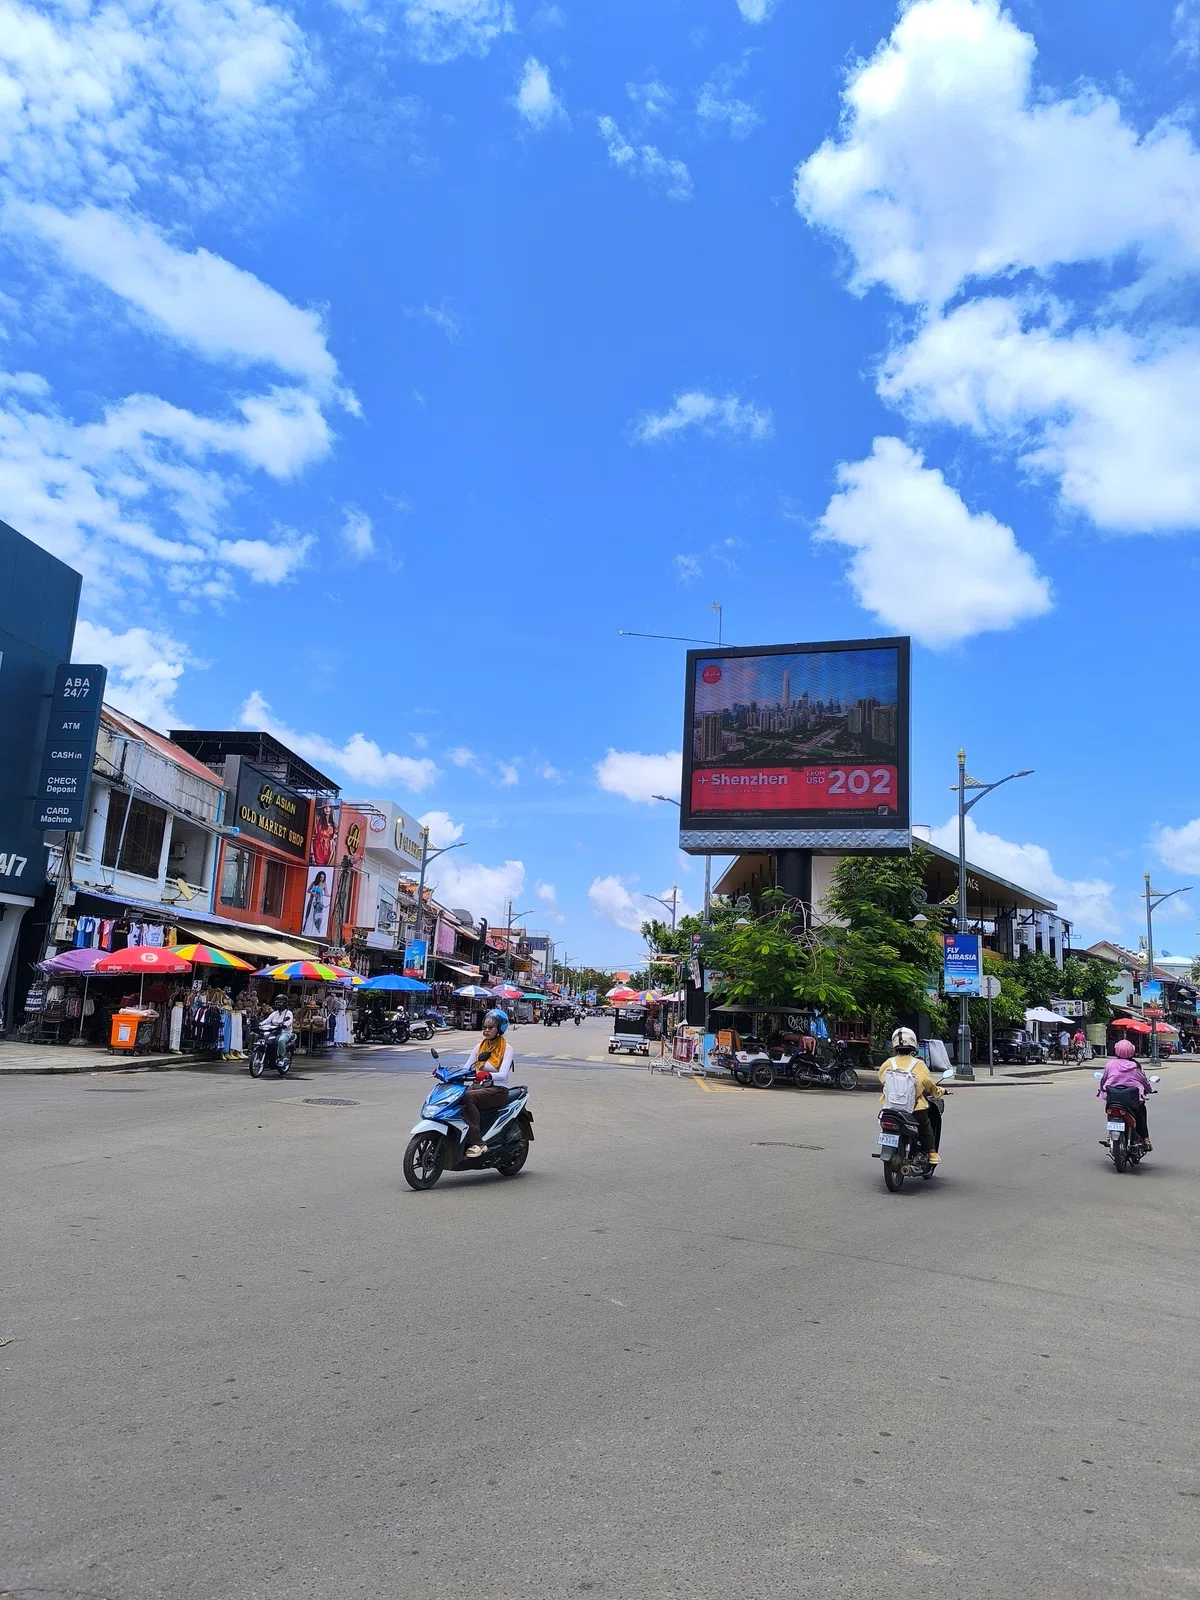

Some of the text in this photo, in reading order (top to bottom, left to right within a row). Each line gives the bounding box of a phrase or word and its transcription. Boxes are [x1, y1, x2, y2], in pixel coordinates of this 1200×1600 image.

[64, 677, 90, 688] ABA
[63, 688, 90, 698] 24/7
[62, 722, 80, 730] ATM
[47, 777, 77, 785] CHECK
[710, 772, 788, 786] Shenzhen
[806, 777, 825, 785] USD
[828, 769, 891, 795] 202
[46, 785, 77, 794] Deposit
[275, 795, 297, 815] ASIAN
[46, 807, 70, 815] CARD
[40, 815, 73, 824] Machine
[241, 805, 257, 824] OLD
[258, 814, 287, 839] MARKET
[288, 830, 304, 847] SHOP
[946, 953, 977, 961] AIRASIA
